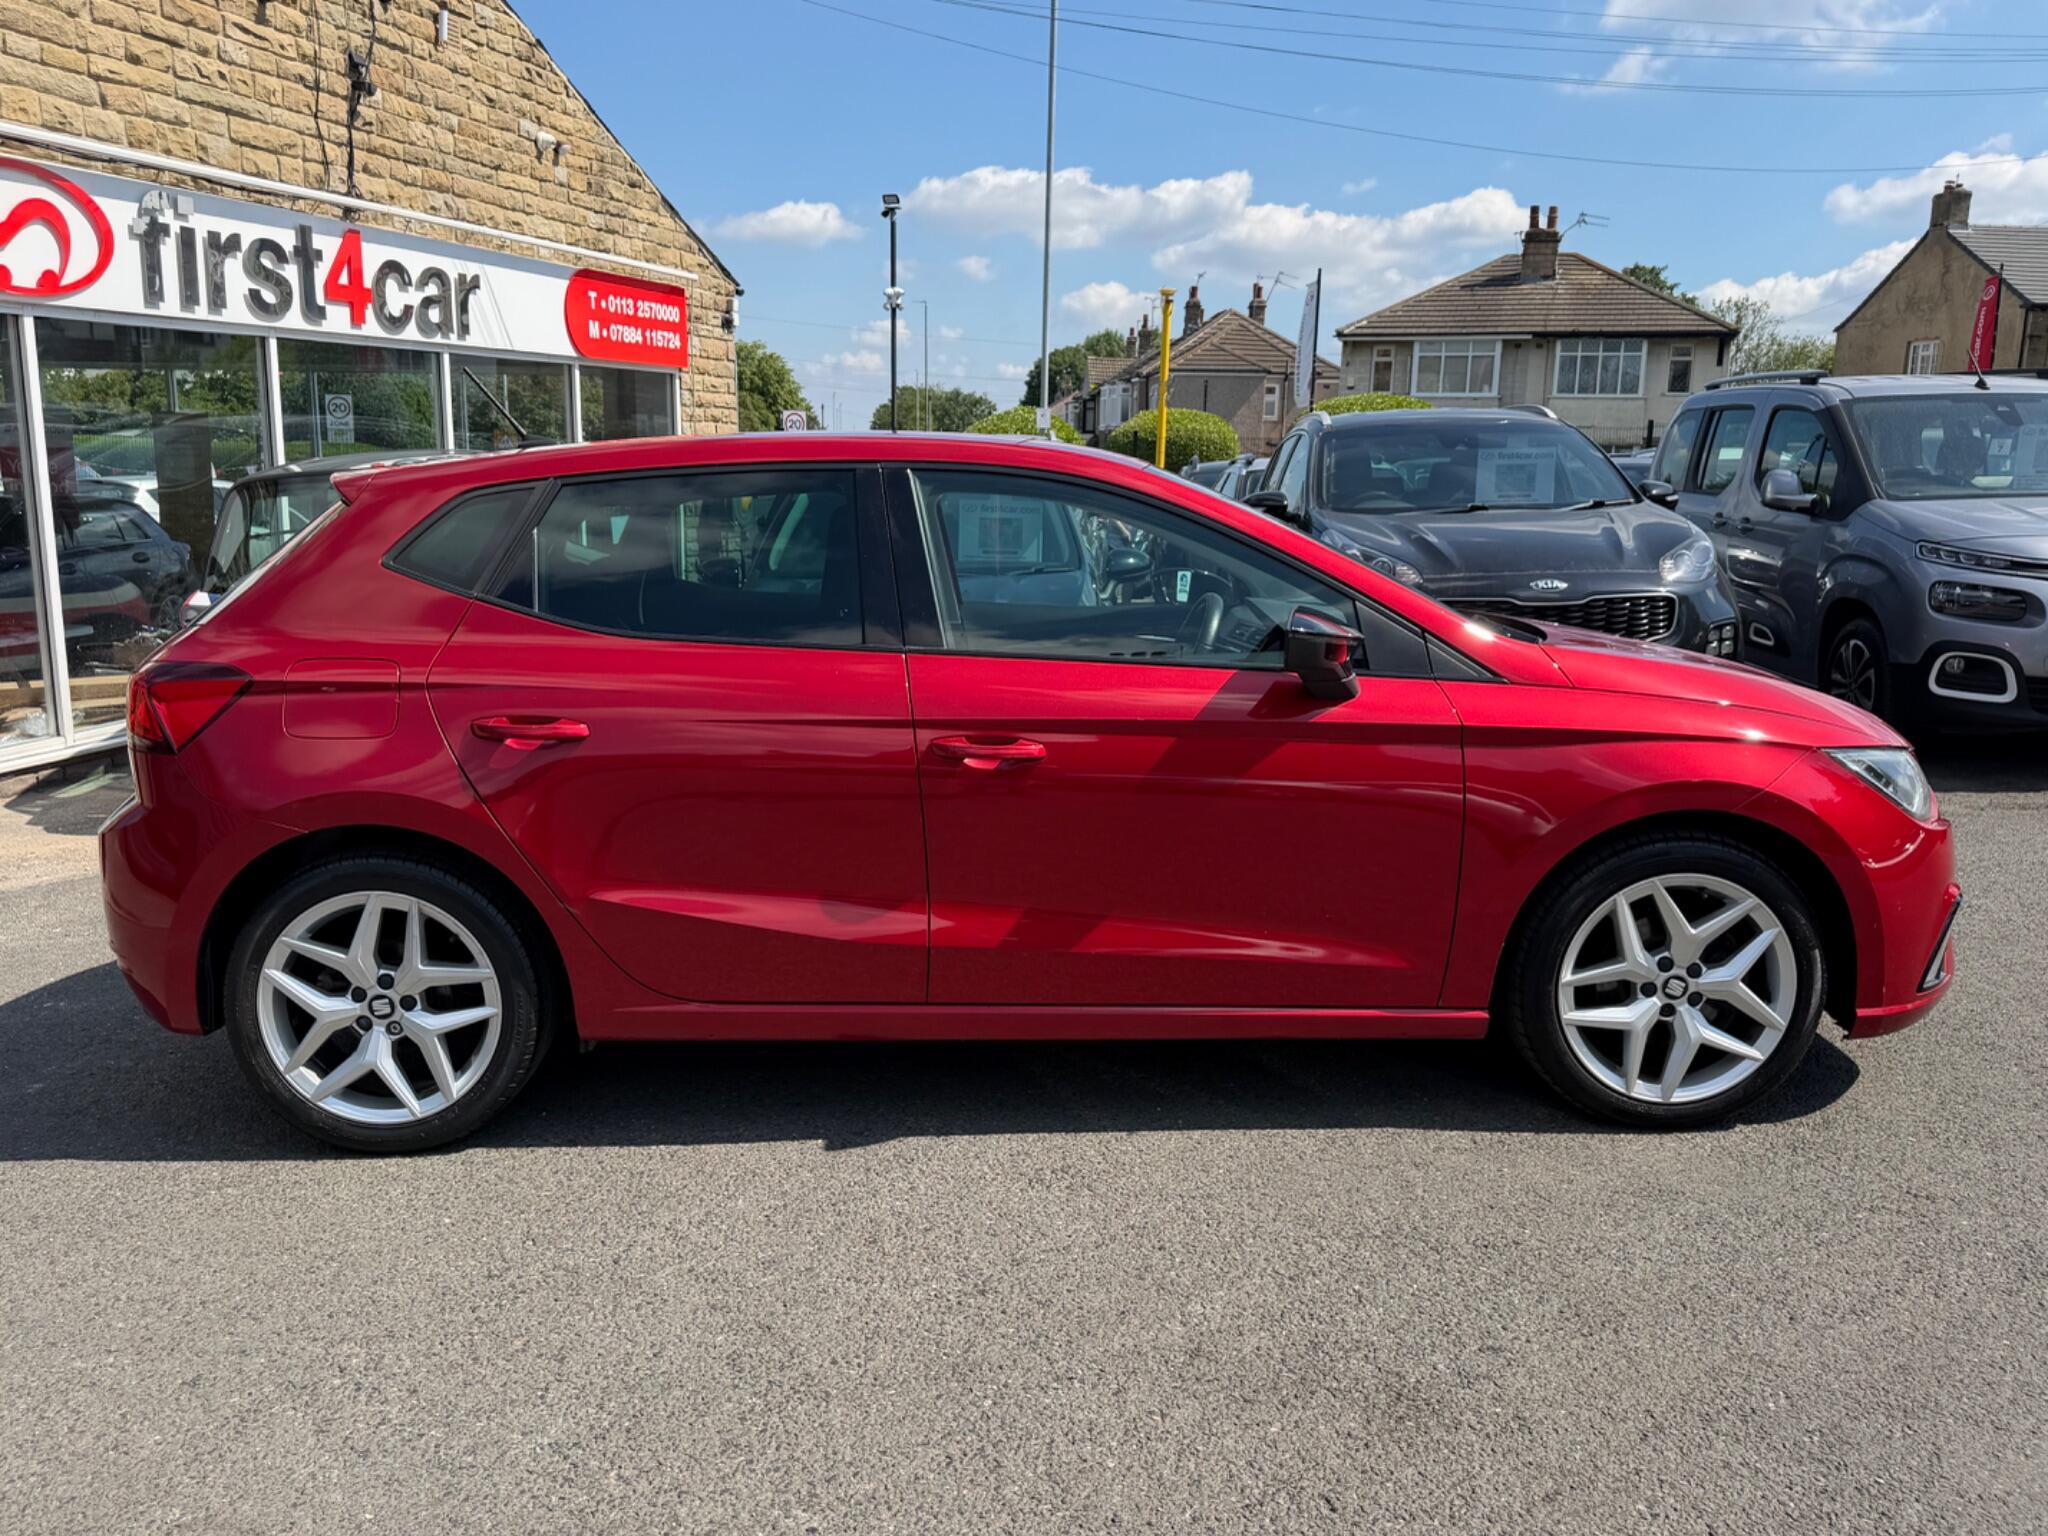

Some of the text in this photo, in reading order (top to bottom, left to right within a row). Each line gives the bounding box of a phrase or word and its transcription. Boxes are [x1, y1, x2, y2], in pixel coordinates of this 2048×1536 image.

[130, 191, 481, 338] first4car
[587, 290, 680, 323] T 0113 2570000
[588, 320, 681, 349] M 07884 115724
[788, 418, 801, 430] 20
